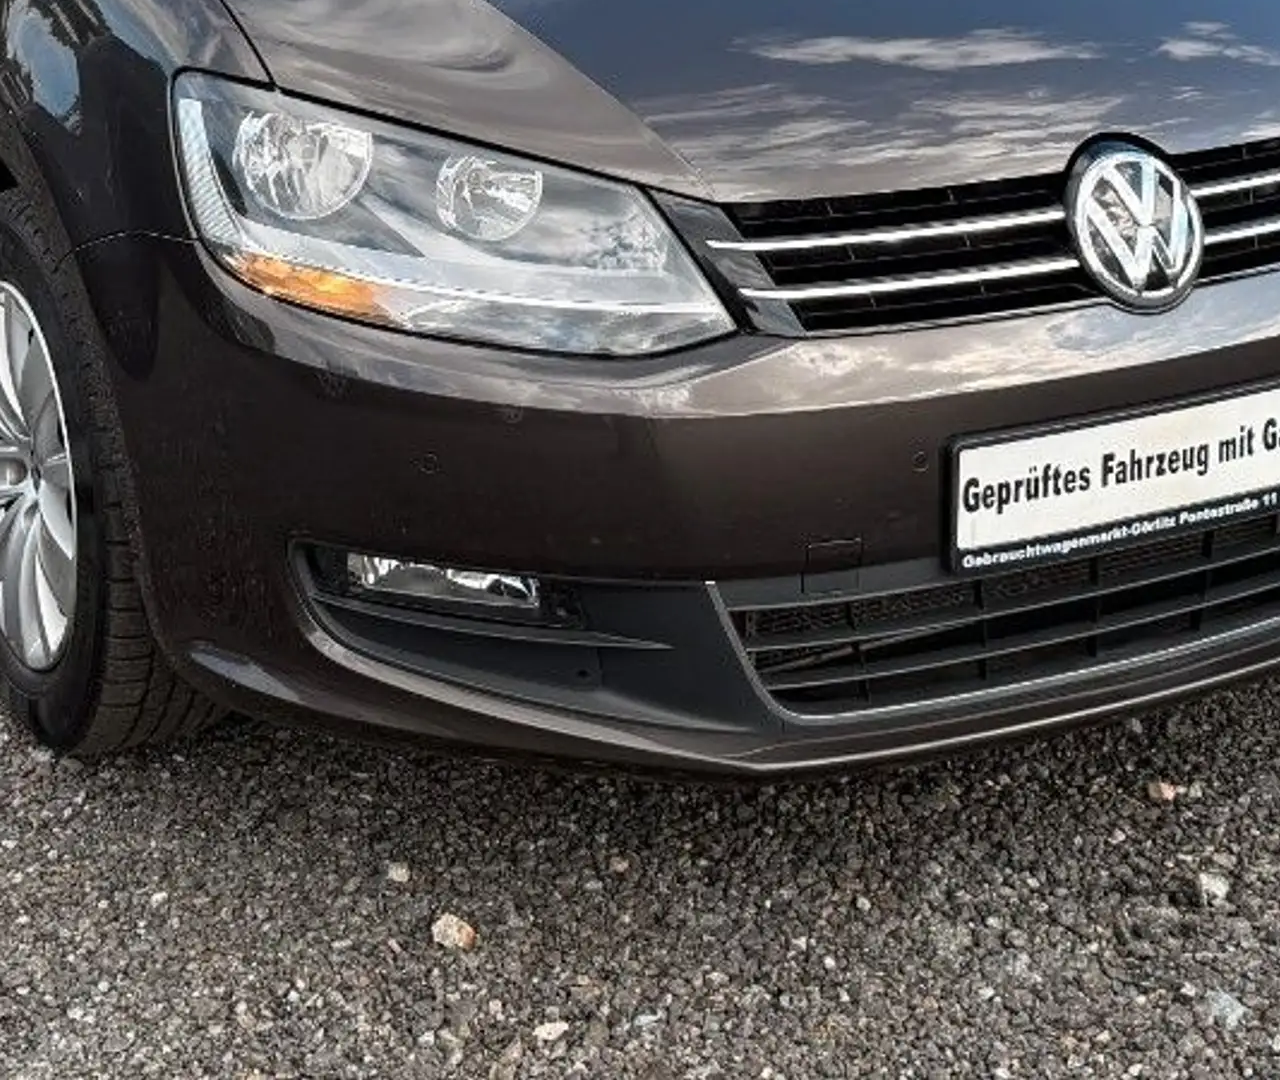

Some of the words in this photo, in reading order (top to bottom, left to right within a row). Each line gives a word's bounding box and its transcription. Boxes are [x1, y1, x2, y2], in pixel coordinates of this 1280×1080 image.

[963, 463, 1091, 515] Geprüftes
[1101, 444, 1209, 487] Fahrzeug
[1219, 425, 1254, 464] mit
[1262, 491, 1278, 506] 11
